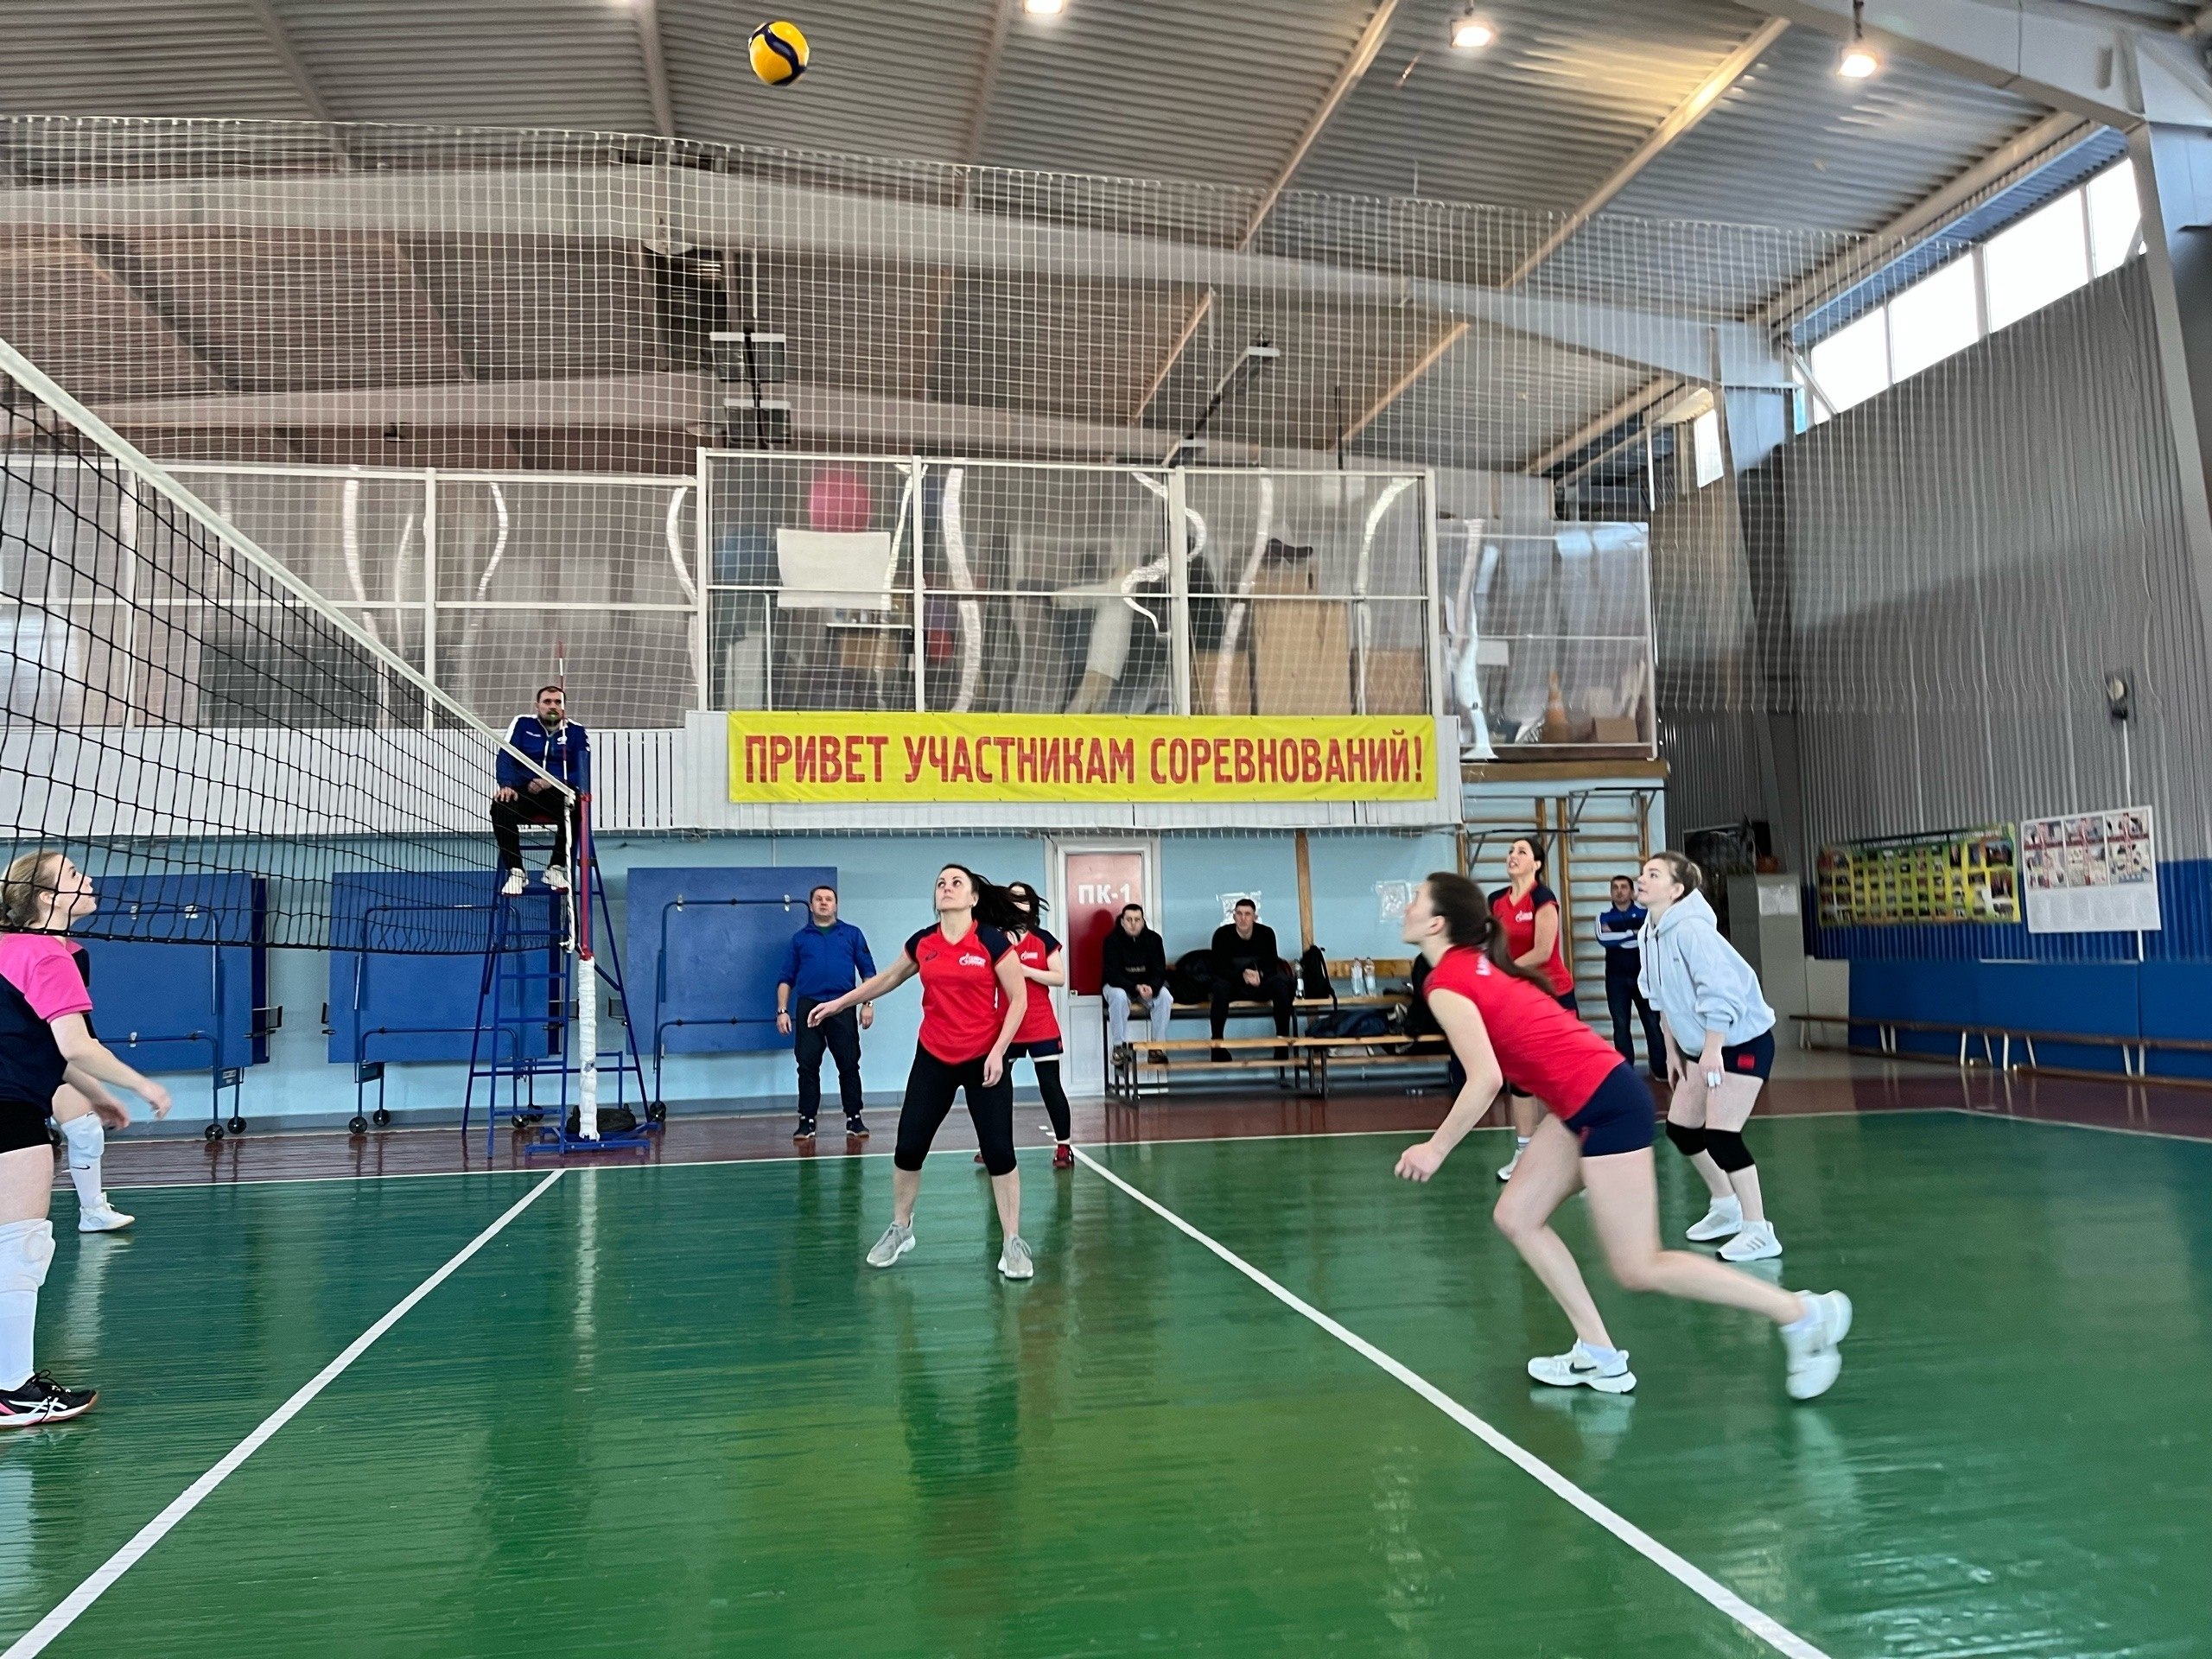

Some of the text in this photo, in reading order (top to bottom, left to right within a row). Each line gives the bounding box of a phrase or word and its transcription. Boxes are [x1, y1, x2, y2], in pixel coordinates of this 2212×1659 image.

[745, 729, 1422, 784] ПРИВЕТ УЧАСТНИКАМ СОРЕВНОВАНИЙ!
[1077, 883, 1131, 905] ПК-1
